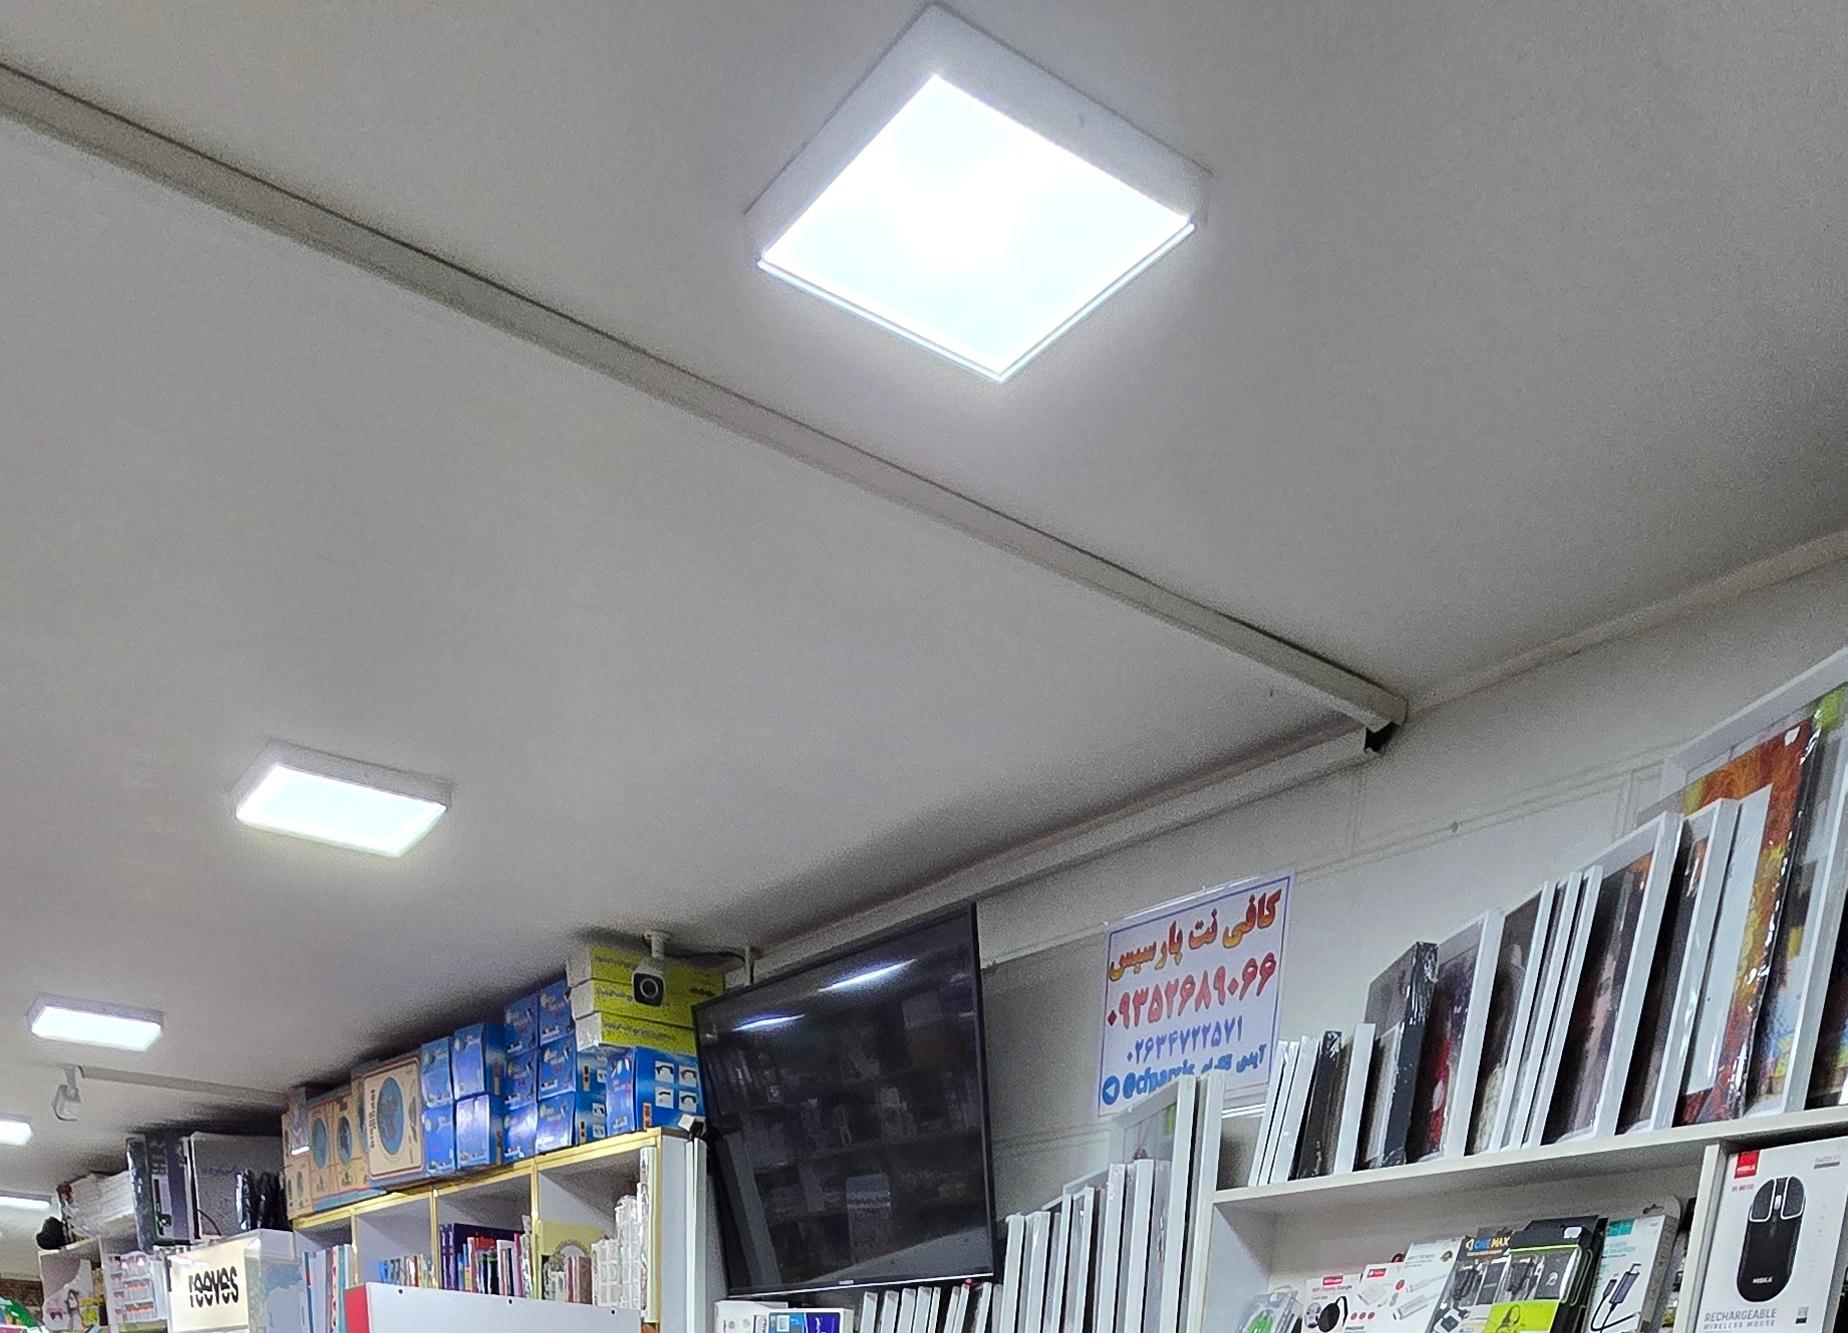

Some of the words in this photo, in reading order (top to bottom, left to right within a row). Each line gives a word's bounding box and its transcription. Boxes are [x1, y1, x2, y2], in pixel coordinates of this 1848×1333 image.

[1188, 908, 1218, 950] نت
[1222, 888, 1282, 949] کافی
[1108, 920, 1184, 982] پارسیس
[188, 1266, 240, 1308] reeves
[1704, 1307, 1778, 1323] RECHARGEABLE
